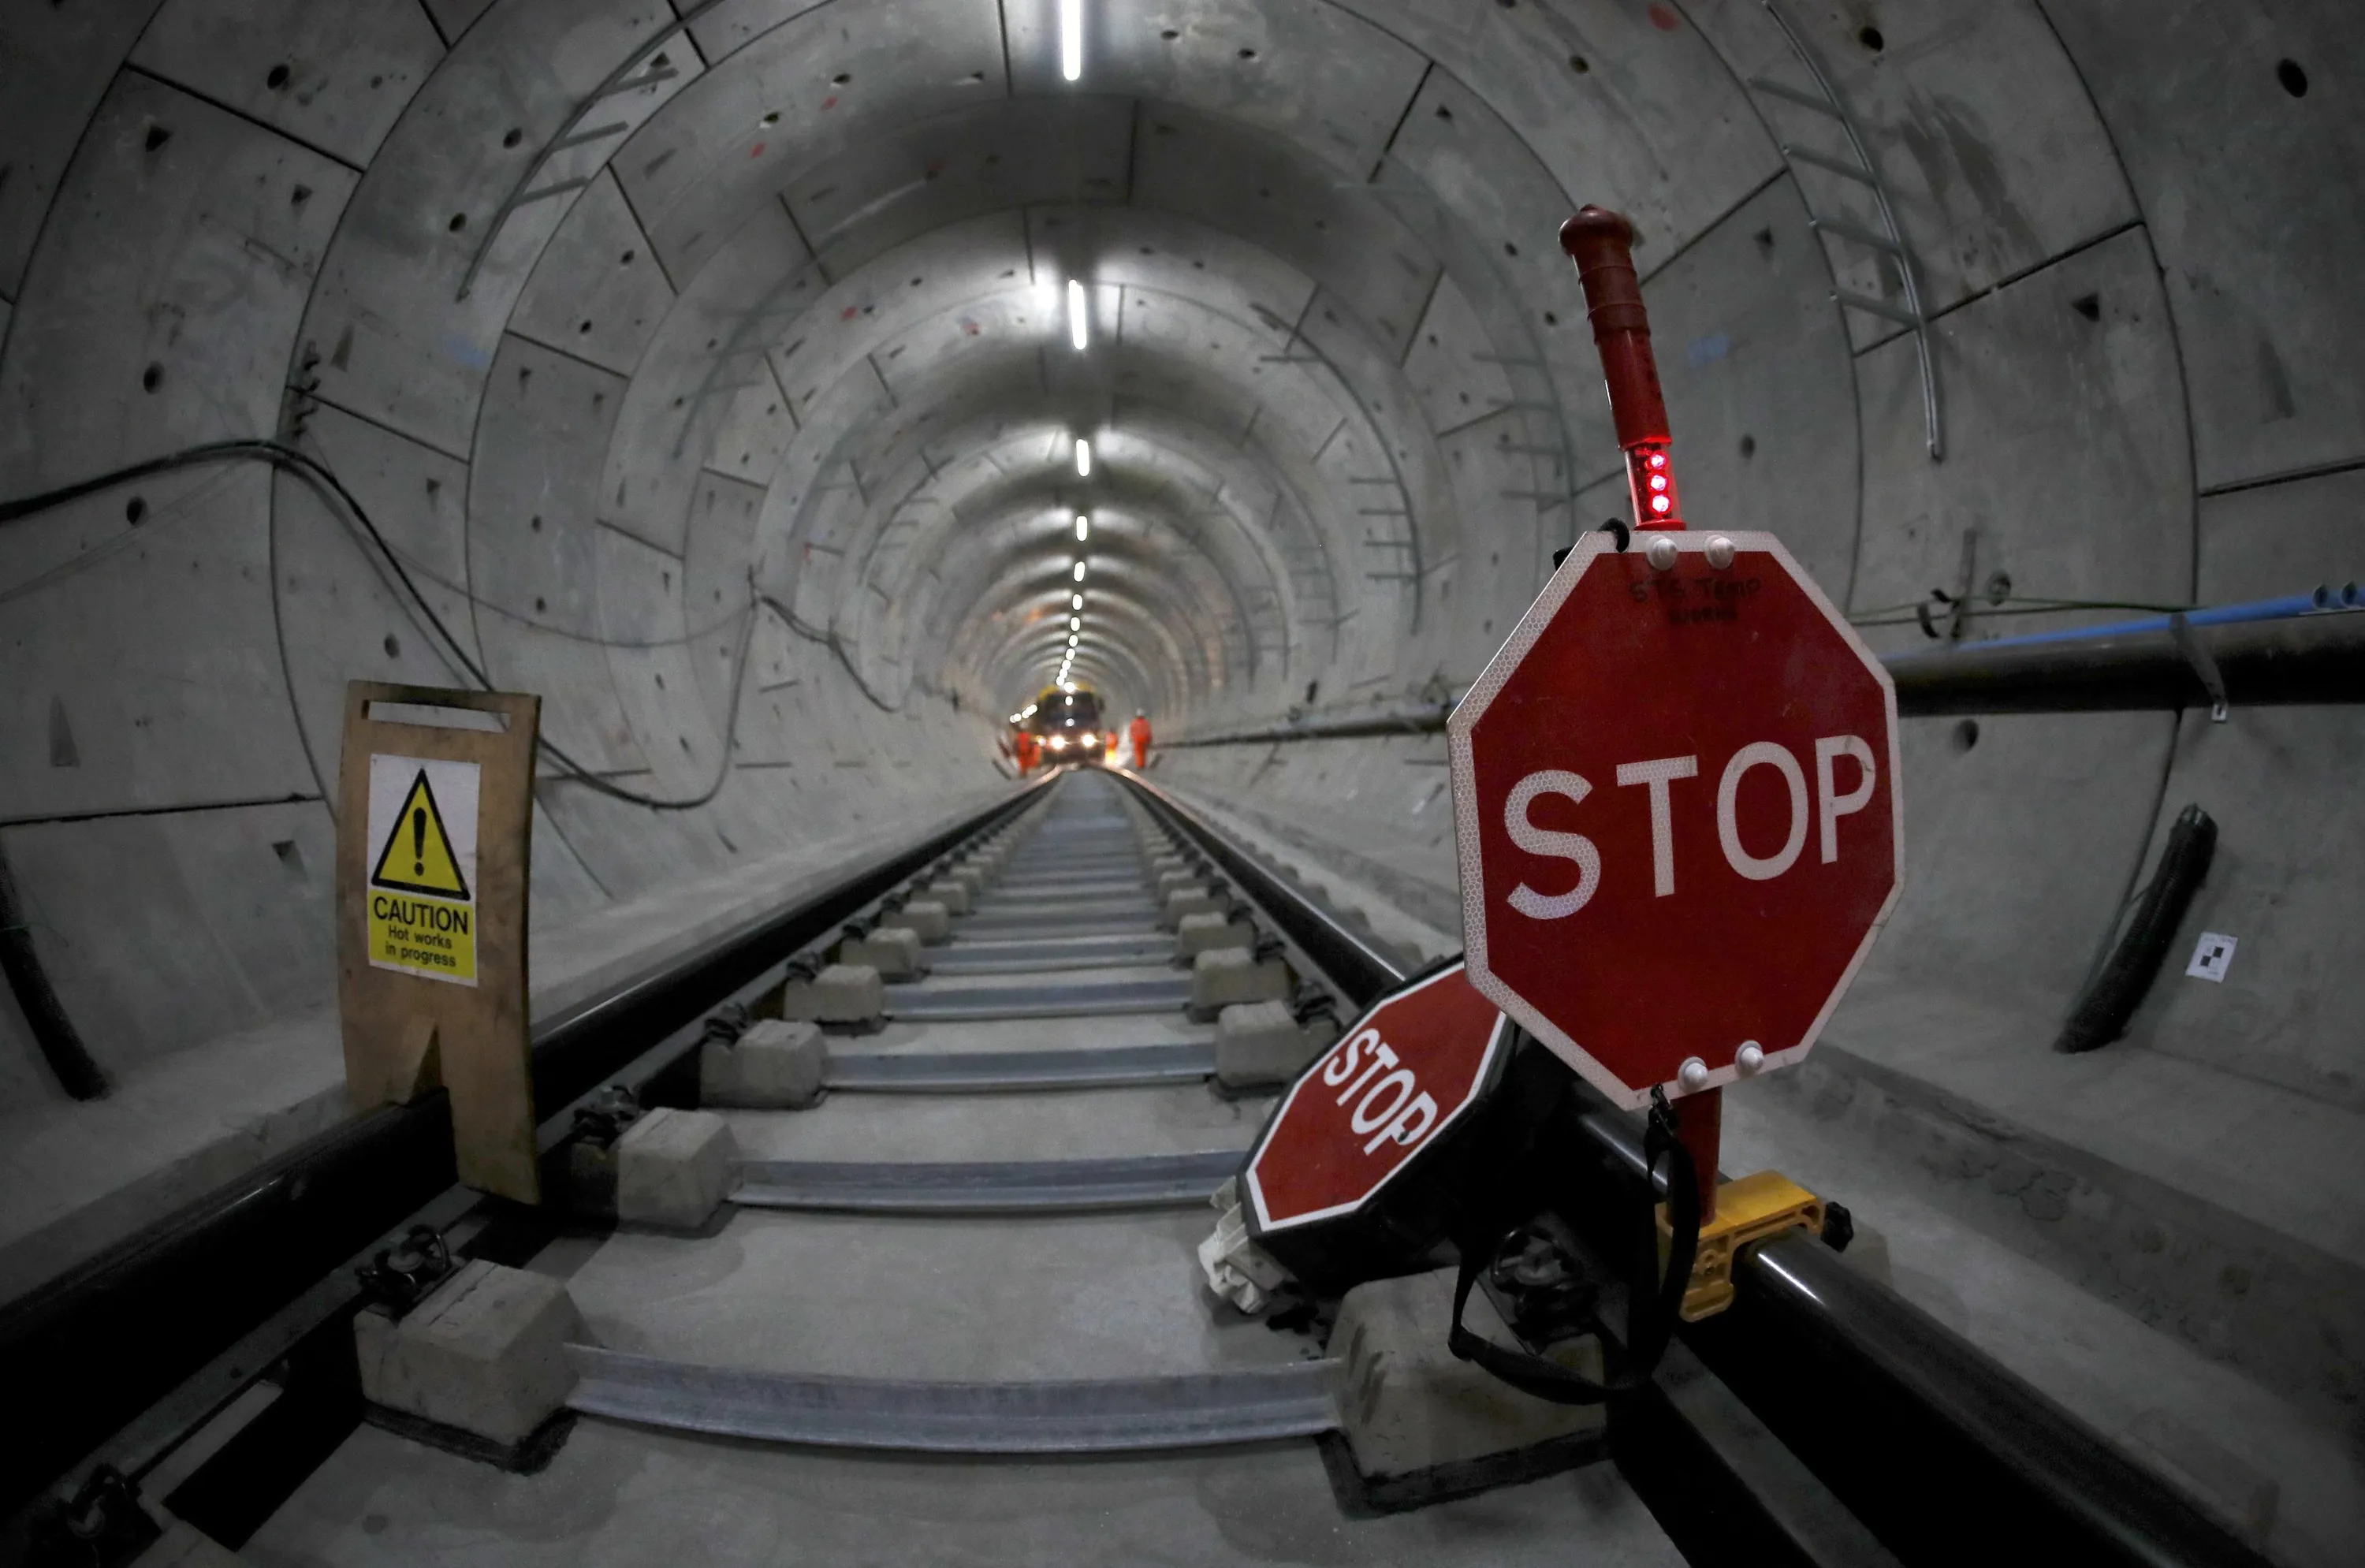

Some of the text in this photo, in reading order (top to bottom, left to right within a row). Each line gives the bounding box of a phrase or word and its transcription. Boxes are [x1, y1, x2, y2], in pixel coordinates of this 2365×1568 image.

[1504, 734, 1876, 920] STOP
[374, 896, 468, 936] CAUTION
[385, 940, 456, 968] in progress
[388, 925, 453, 950] Hot works
[1323, 1028, 1438, 1156] STOP
